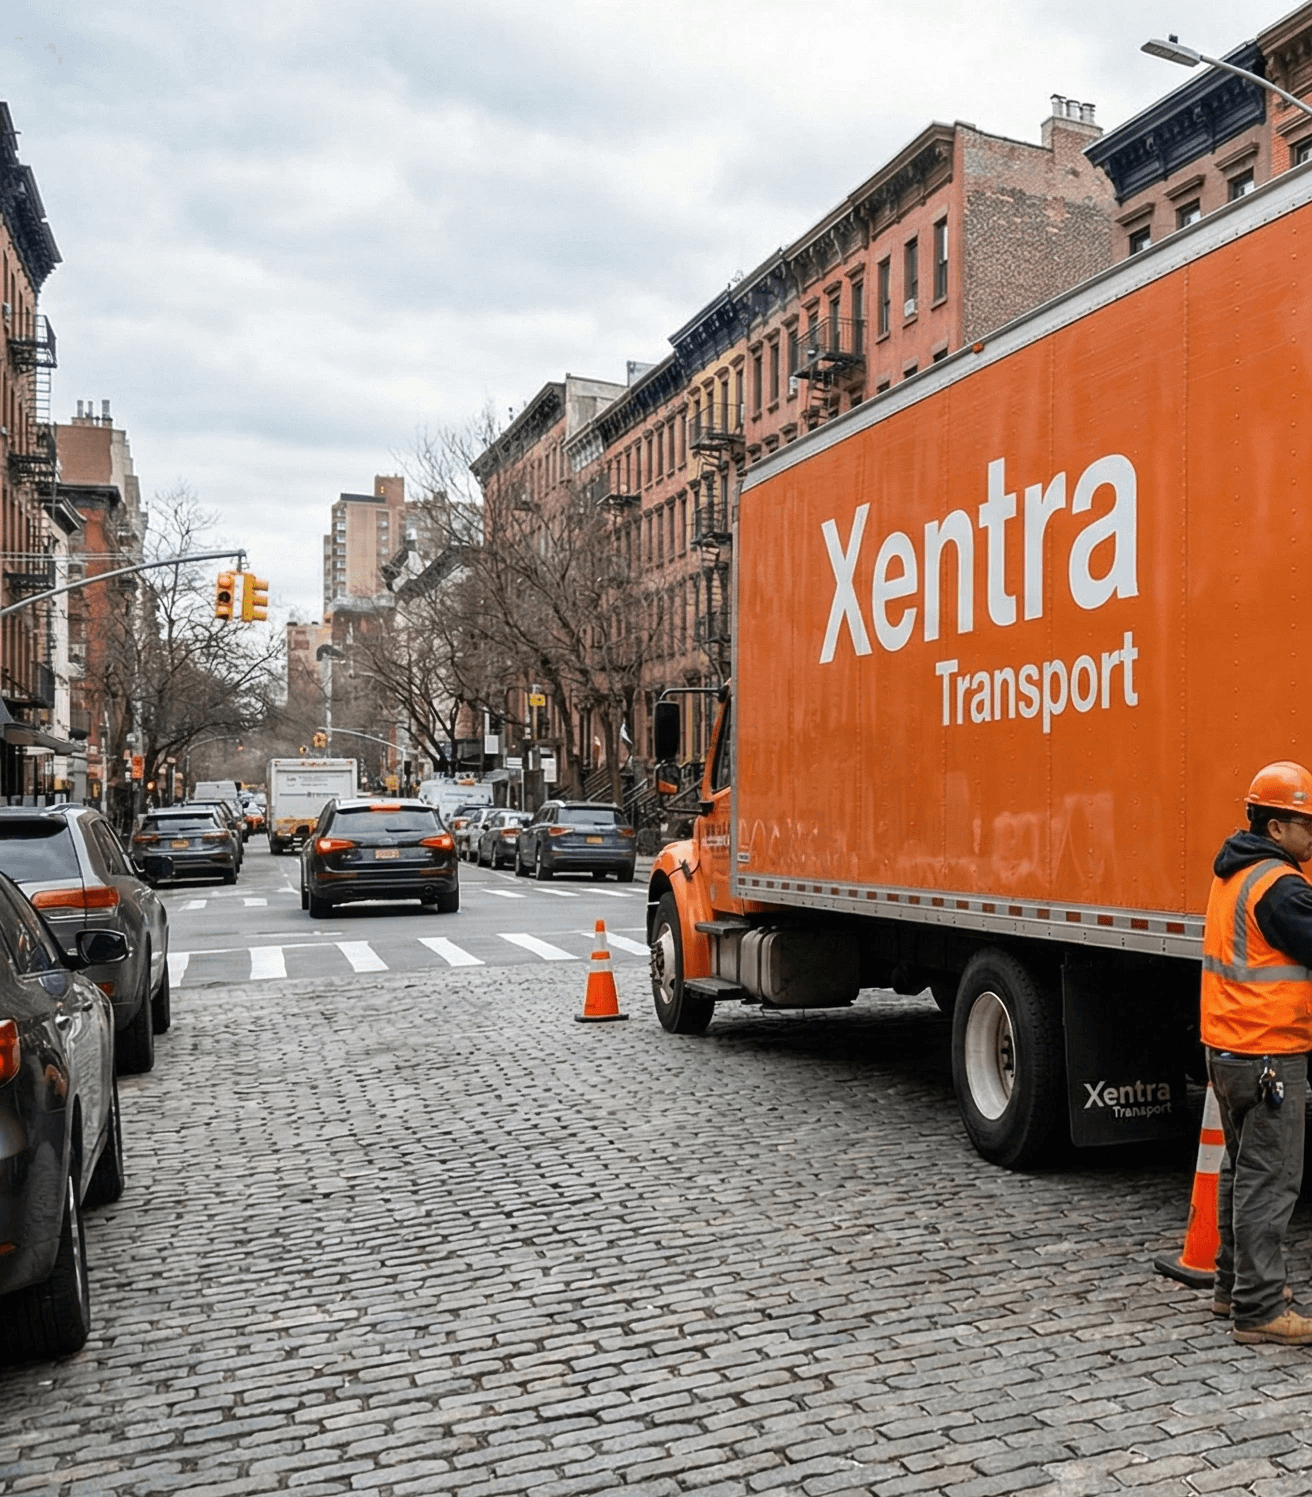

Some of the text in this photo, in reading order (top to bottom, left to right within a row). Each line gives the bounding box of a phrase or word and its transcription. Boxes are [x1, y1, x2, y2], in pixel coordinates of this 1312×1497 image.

[820, 455, 1138, 664] Xentra
[936, 631, 1139, 733] Transport
[1083, 1080, 1171, 1109] Xentra
[1112, 1102, 1172, 1118] Transport
